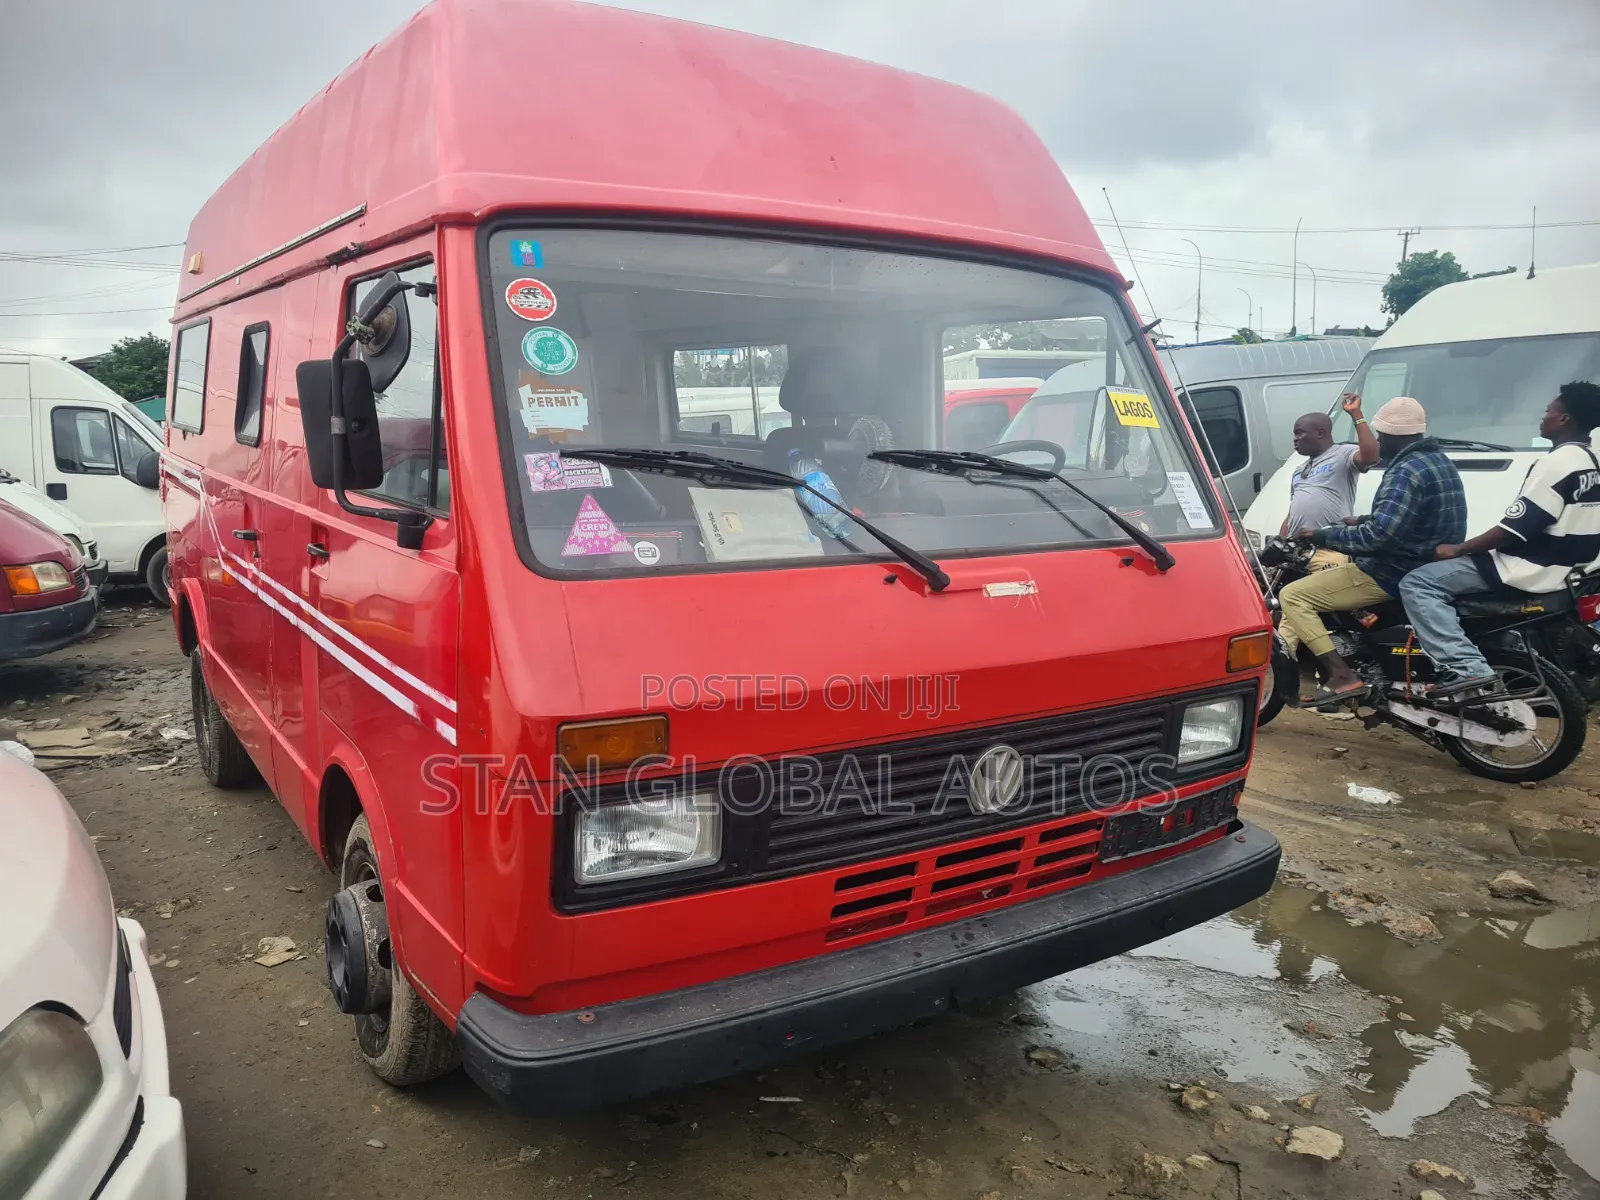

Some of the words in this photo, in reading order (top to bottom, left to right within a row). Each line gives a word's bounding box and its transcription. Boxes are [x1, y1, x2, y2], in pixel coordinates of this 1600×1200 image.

[527, 395, 579, 408] PERMIT
[1114, 399, 1153, 419] LAGOS
[564, 467, 600, 476] BACKSTAGE
[581, 522, 608, 531] CREW
